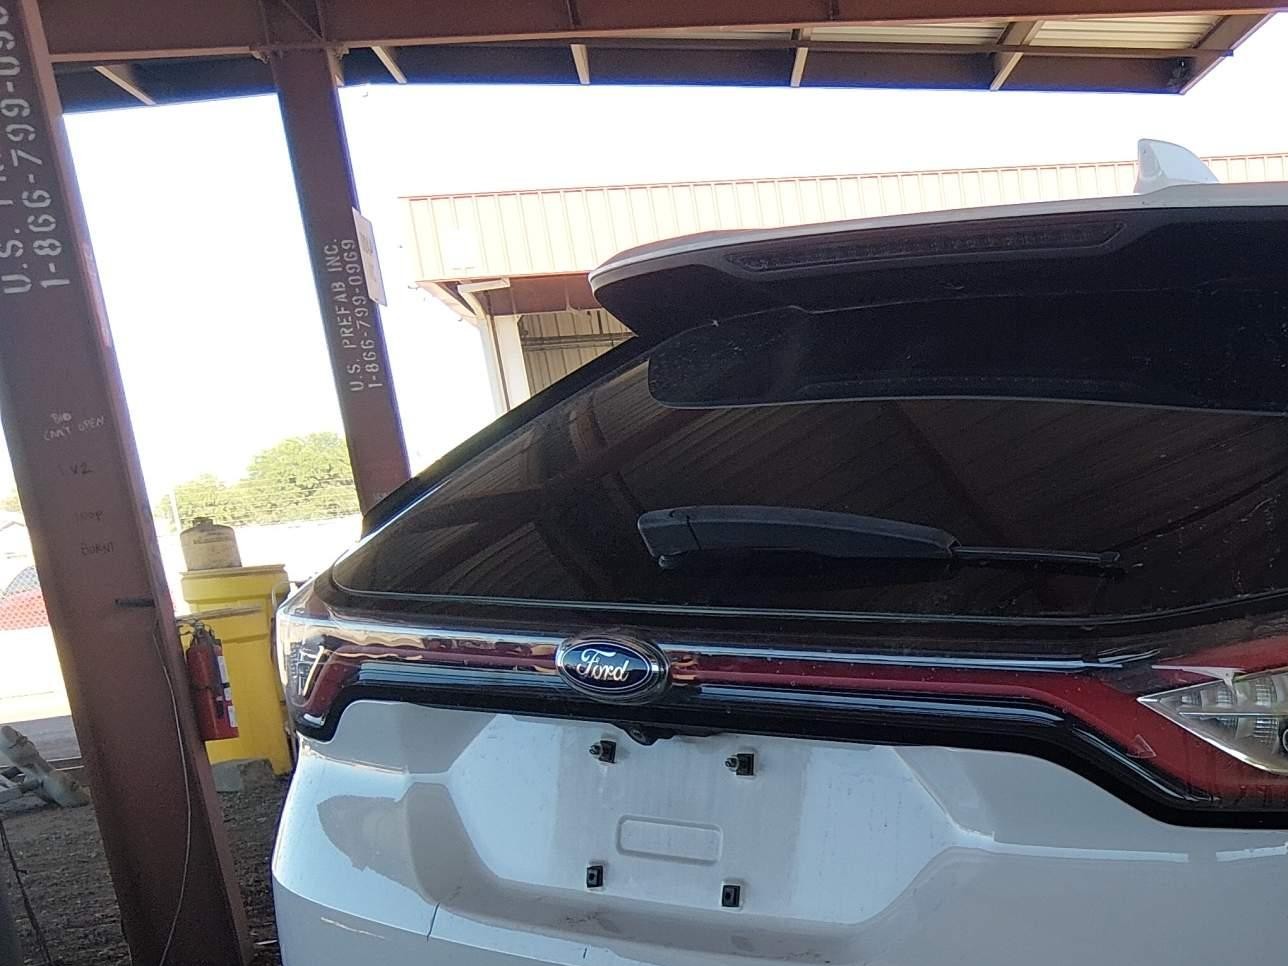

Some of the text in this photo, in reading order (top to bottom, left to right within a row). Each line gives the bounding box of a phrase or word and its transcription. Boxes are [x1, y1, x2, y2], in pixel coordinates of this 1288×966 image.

[324, 239, 365, 392] U.S. PREFAB INC.
[576, 648, 630, 682] Ford
